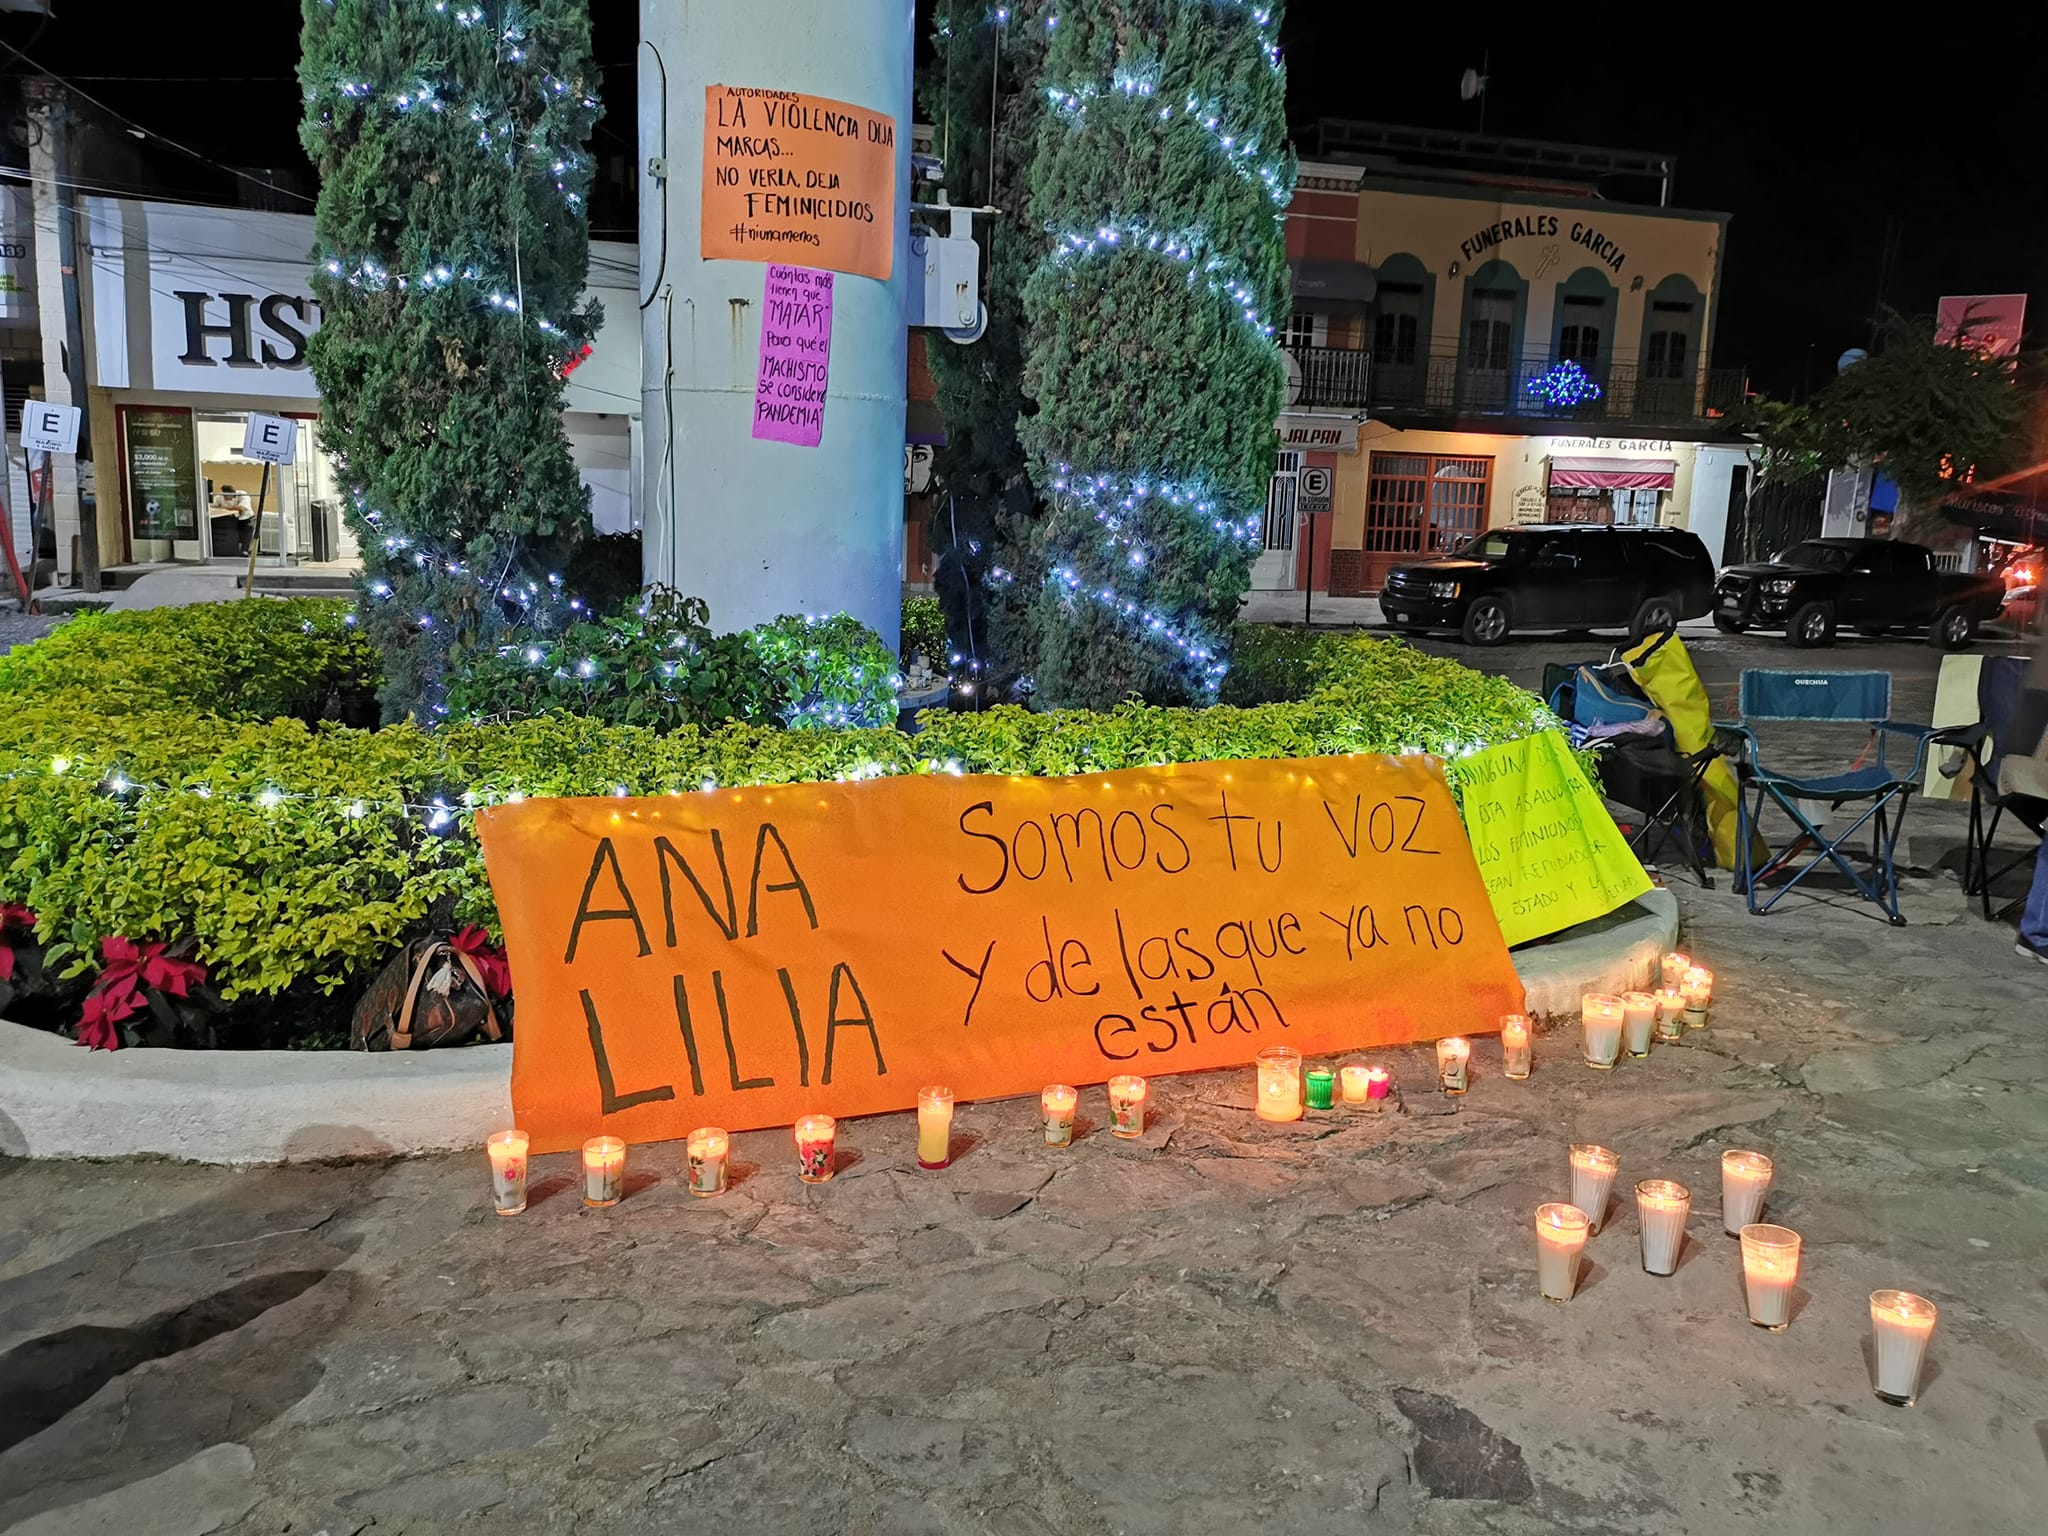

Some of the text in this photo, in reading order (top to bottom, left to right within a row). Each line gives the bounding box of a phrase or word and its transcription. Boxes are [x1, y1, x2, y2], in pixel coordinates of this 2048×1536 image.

[718, 97, 746, 128] LA
[764, 101, 858, 140] VIOLENCIA
[716, 166, 739, 187] NO
[806, 170, 840, 189] DEJA
[744, 192, 873, 223] FEMINICIDIOS
[730, 222, 820, 247] #niunamenos
[1460, 215, 1626, 273] FUNERALES GARCIA
[803, 289, 822, 302] que
[173, 291, 325, 366] HS
[763, 356, 826, 382] MACHISMO
[42, 412, 60, 433] E
[263, 424, 279, 444] E
[1284, 428, 1342, 444] JALPAN
[1551, 438, 1612, 449] FUNERALES
[1309, 474, 1322, 490] E
[1208, 789, 1283, 873] tu
[1478, 840, 1501, 866] LOS
[564, 822, 820, 964] ANA
[1512, 890, 1560, 916] ESTADO
[1565, 881, 1579, 901] Y
[1024, 915, 1100, 1003] de
[1114, 907, 1216, 1001] las
[1214, 911, 1308, 988] que
[1403, 902, 1464, 947] no
[1093, 981, 1291, 1062] están
[579, 961, 888, 1116] LILIA
